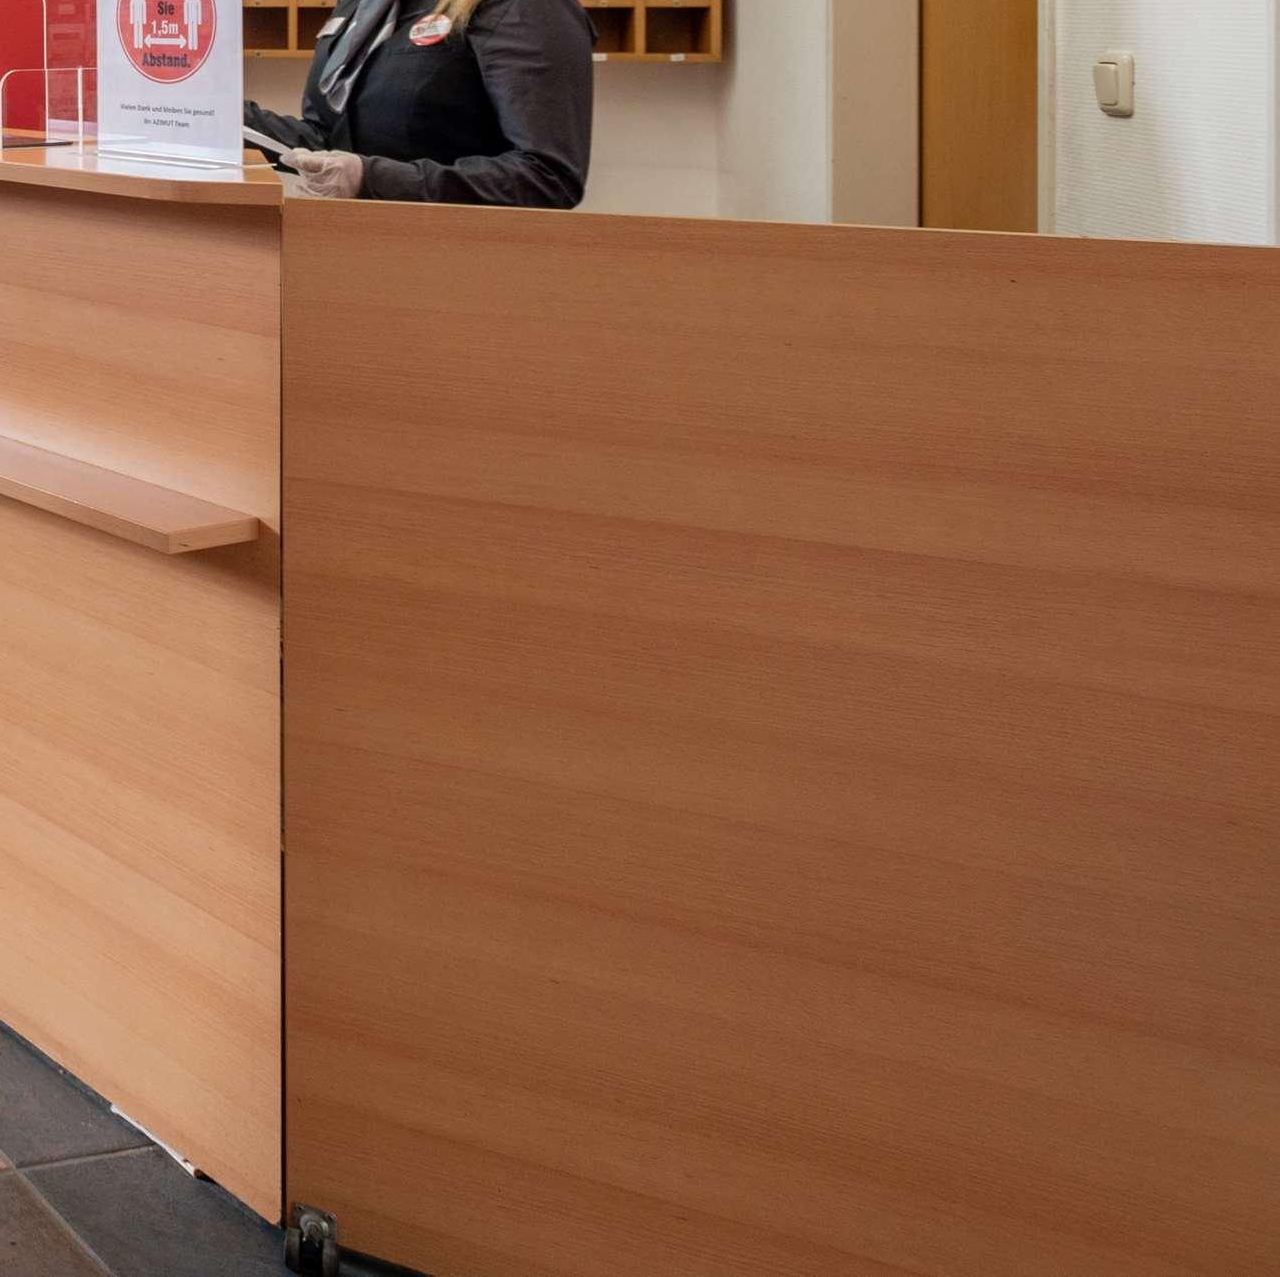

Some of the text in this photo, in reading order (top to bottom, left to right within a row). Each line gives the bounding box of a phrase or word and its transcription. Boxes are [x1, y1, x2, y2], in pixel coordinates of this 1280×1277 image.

[157, 1, 175, 16] Sie
[151, 20, 179, 36] 1,5m
[142, 52, 191, 69] Abstand.
